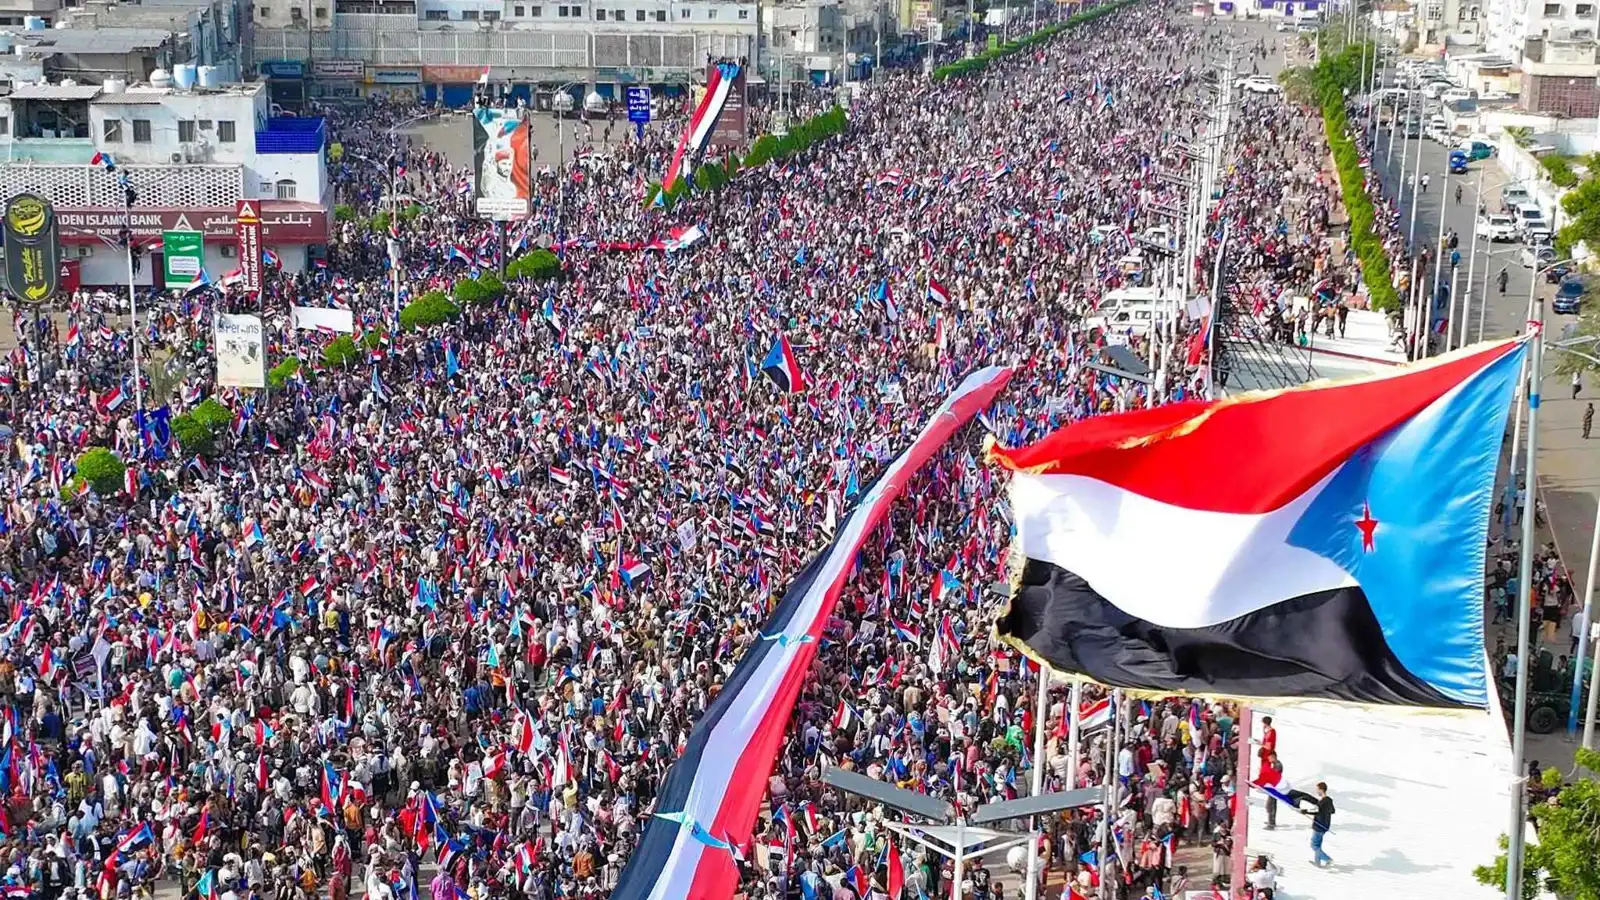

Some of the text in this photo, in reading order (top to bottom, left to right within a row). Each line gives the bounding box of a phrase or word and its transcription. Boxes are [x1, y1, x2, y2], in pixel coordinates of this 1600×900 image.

[131, 214, 163, 225] BANK
[282, 213, 312, 227] بنك
[251, 272, 259, 291] ADEN
